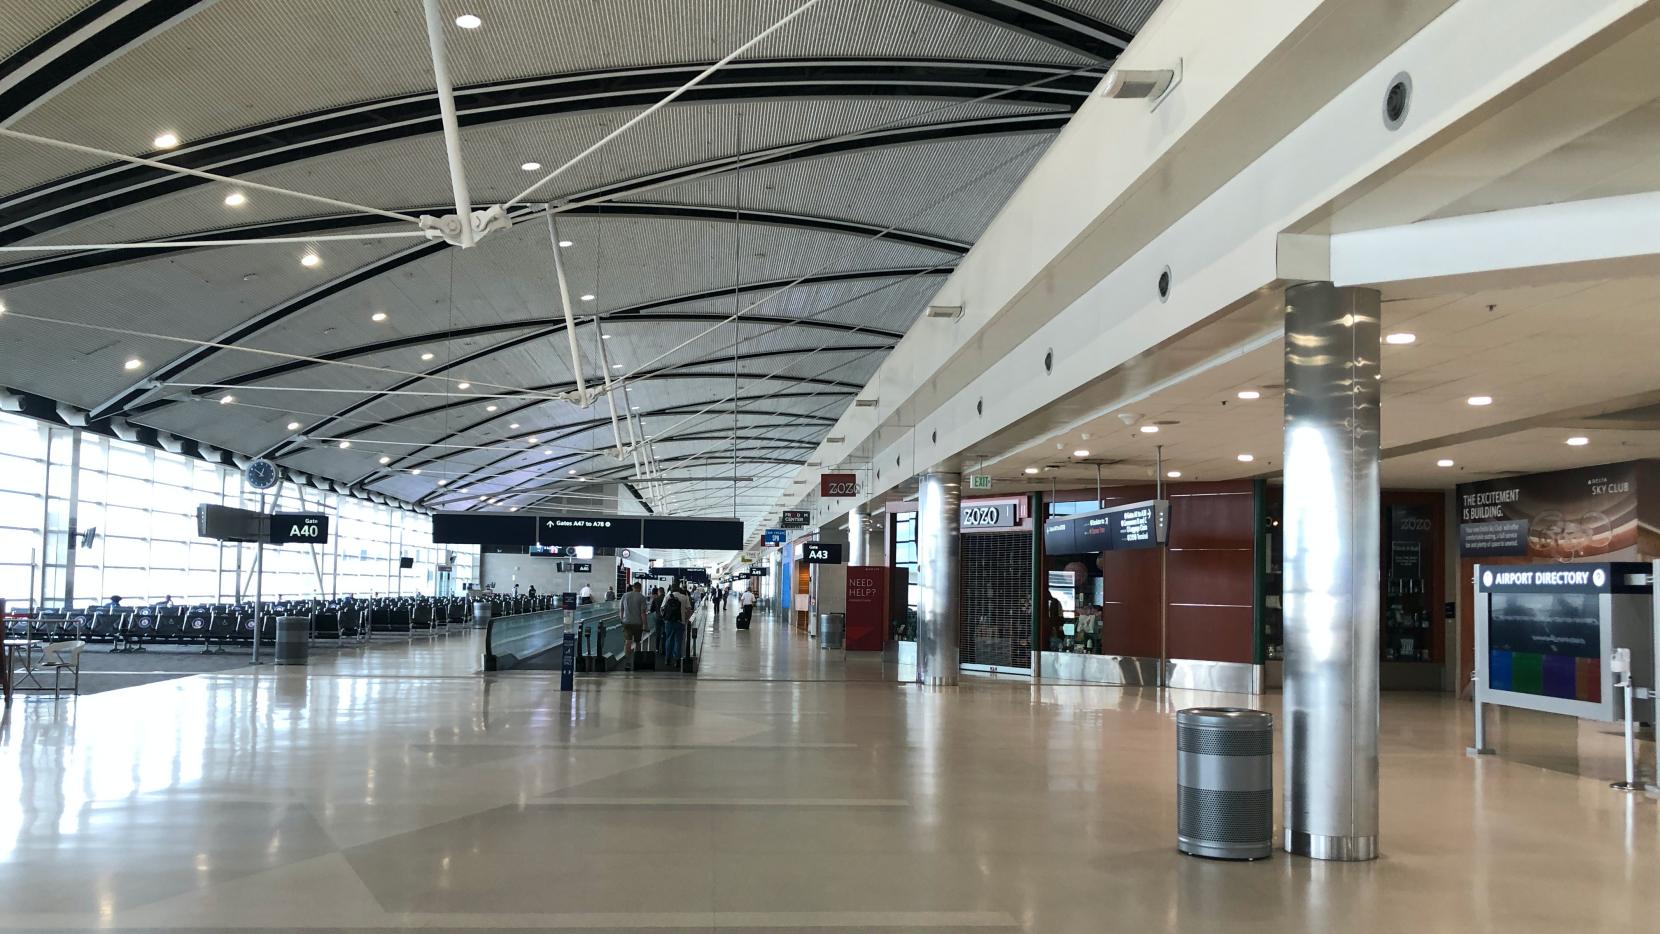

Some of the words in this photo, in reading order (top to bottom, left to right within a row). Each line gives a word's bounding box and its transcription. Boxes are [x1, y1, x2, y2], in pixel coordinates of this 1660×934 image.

[974, 476, 989, 487] EXIT
[1591, 484, 1607, 495] SKY
[1608, 482, 1629, 493] CLUB
[1463, 494, 1476, 506] THE
[1477, 489, 1520, 505] EXCITEMENT
[963, 506, 999, 525] ZOZO
[1463, 508, 1470, 520] IS
[1470, 505, 1504, 520] BUILDING.
[289, 524, 319, 537] A40
[808, 550, 828, 559] A43
[849, 578, 874, 587] NEED
[1494, 572, 1533, 585] AIRPORT
[1535, 571, 1590, 584] DIRECTORY
[849, 588, 877, 597] HELP?
